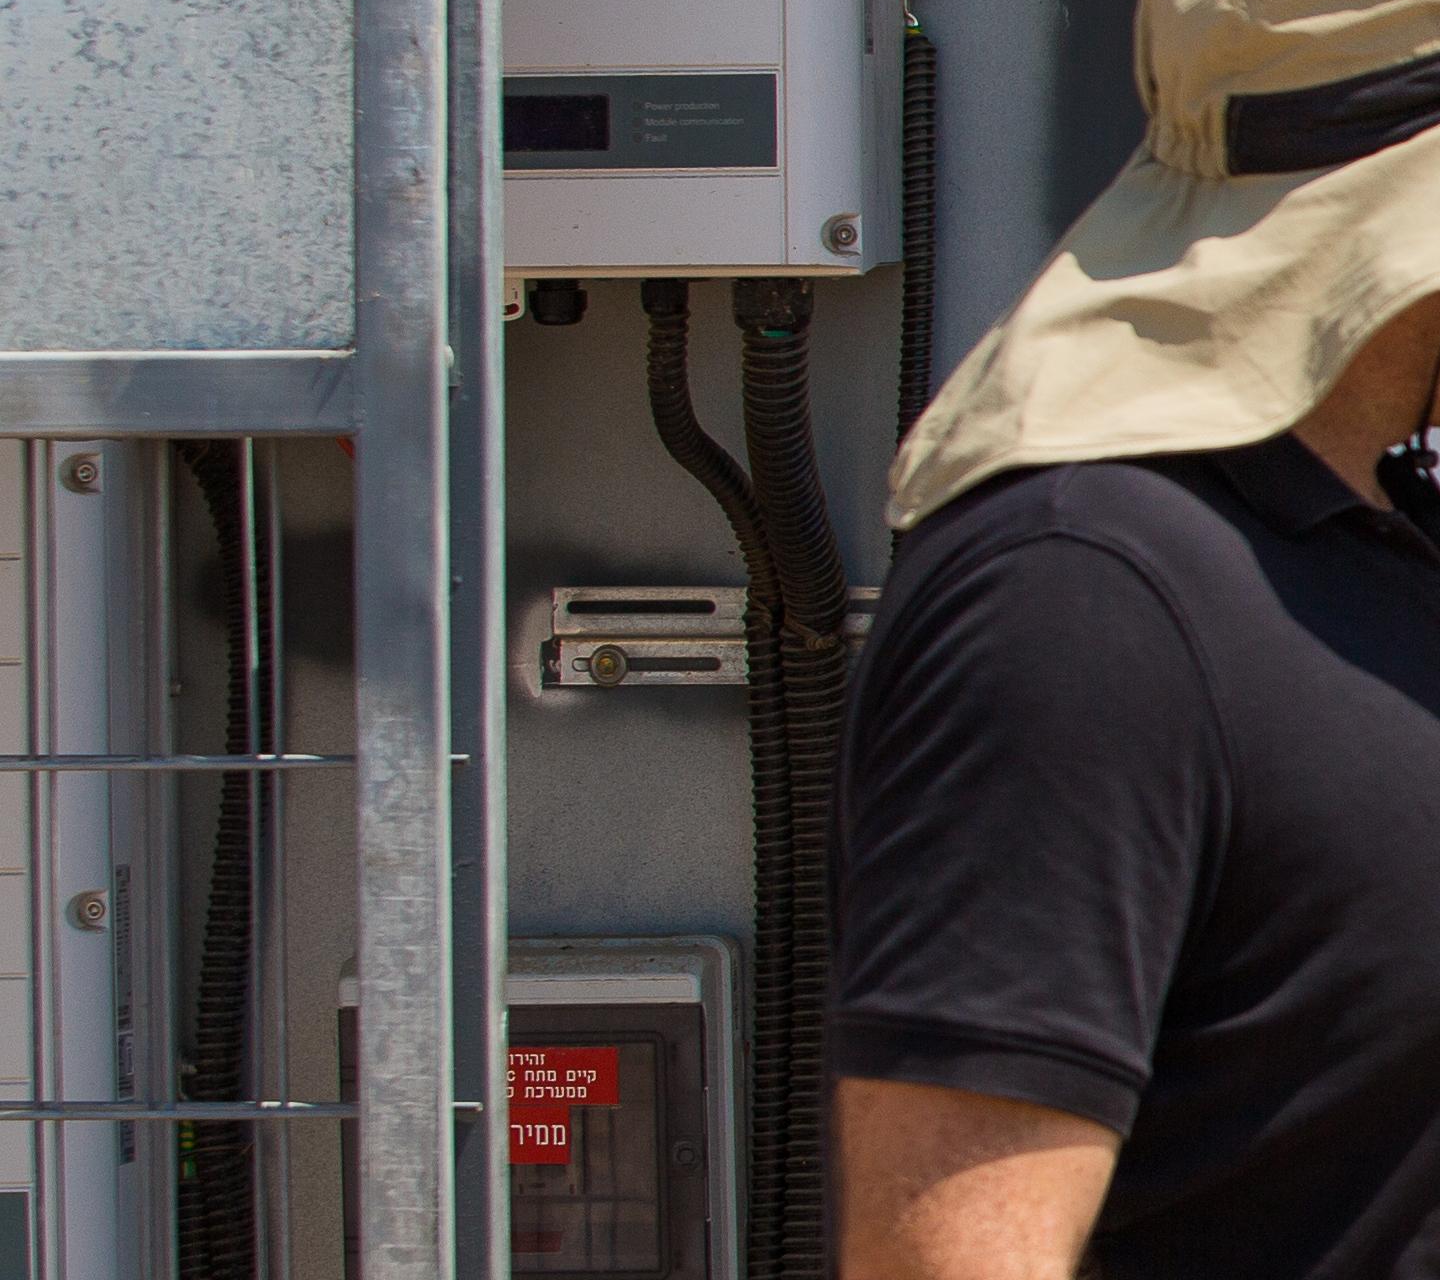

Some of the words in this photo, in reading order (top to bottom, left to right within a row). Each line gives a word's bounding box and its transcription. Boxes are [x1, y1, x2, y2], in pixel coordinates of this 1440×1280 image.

[509, 1053, 546, 1066] זהירו
[524, 1070, 557, 1082] מתח
[566, 1070, 597, 1084] קיים
[524, 1086, 587, 1099] ממערכת
[510, 1124, 566, 1145] ממיר
